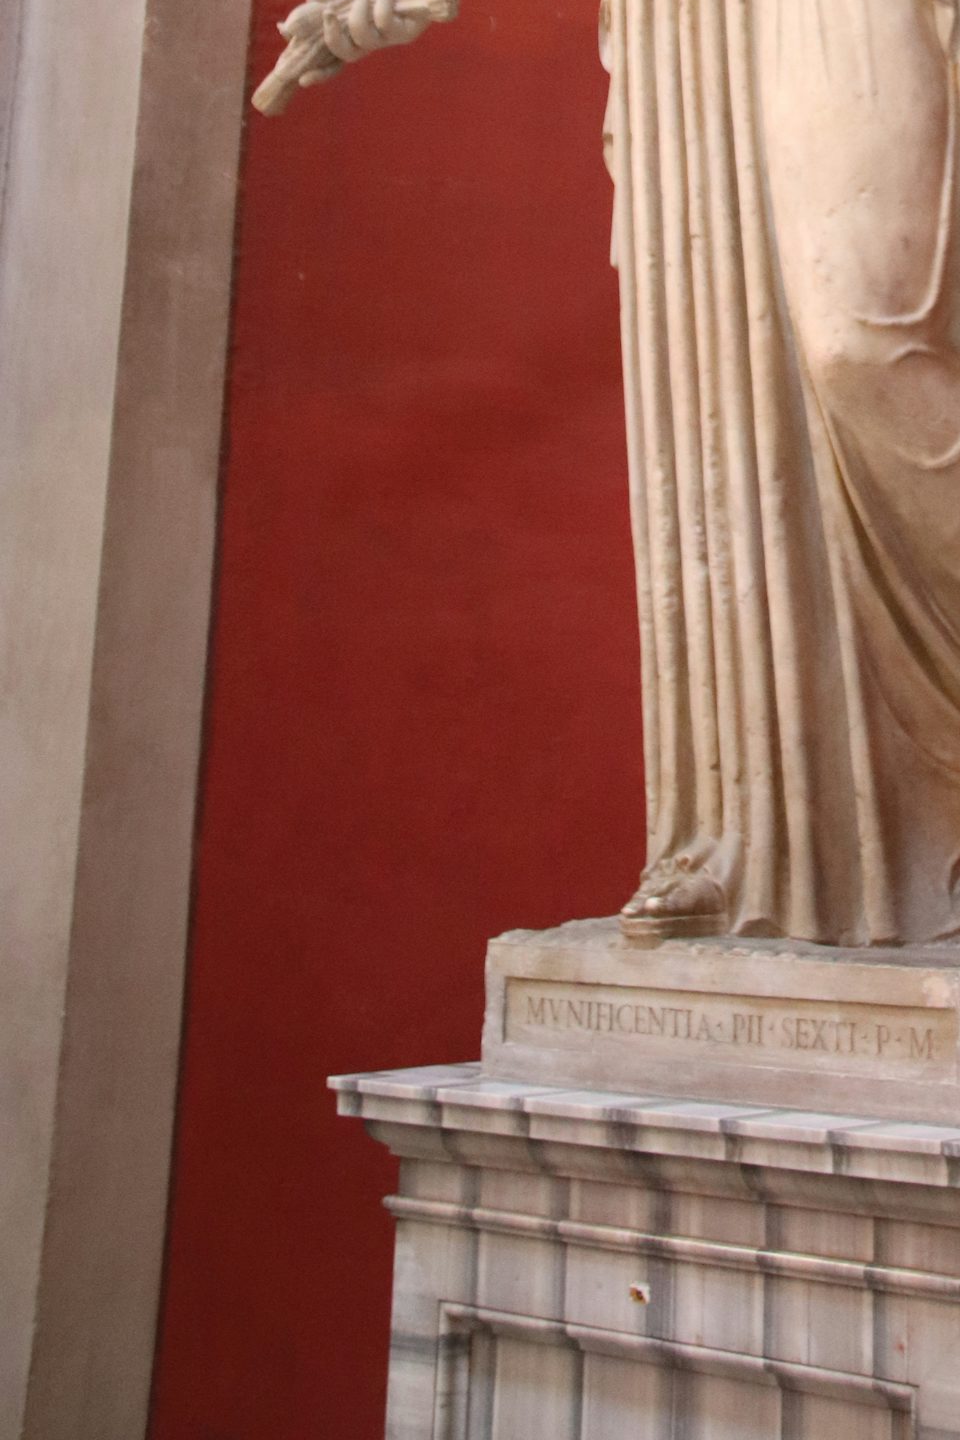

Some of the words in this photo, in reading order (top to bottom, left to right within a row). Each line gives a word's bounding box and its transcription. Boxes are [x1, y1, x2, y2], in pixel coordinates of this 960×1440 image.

[525, 996, 713, 1041] MVNIFICENTIA
[732, 1013, 764, 1046] PII
[781, 1018, 857, 1055] SEXTI
[875, 1024, 890, 1057] P
[909, 1027, 936, 1059] M
